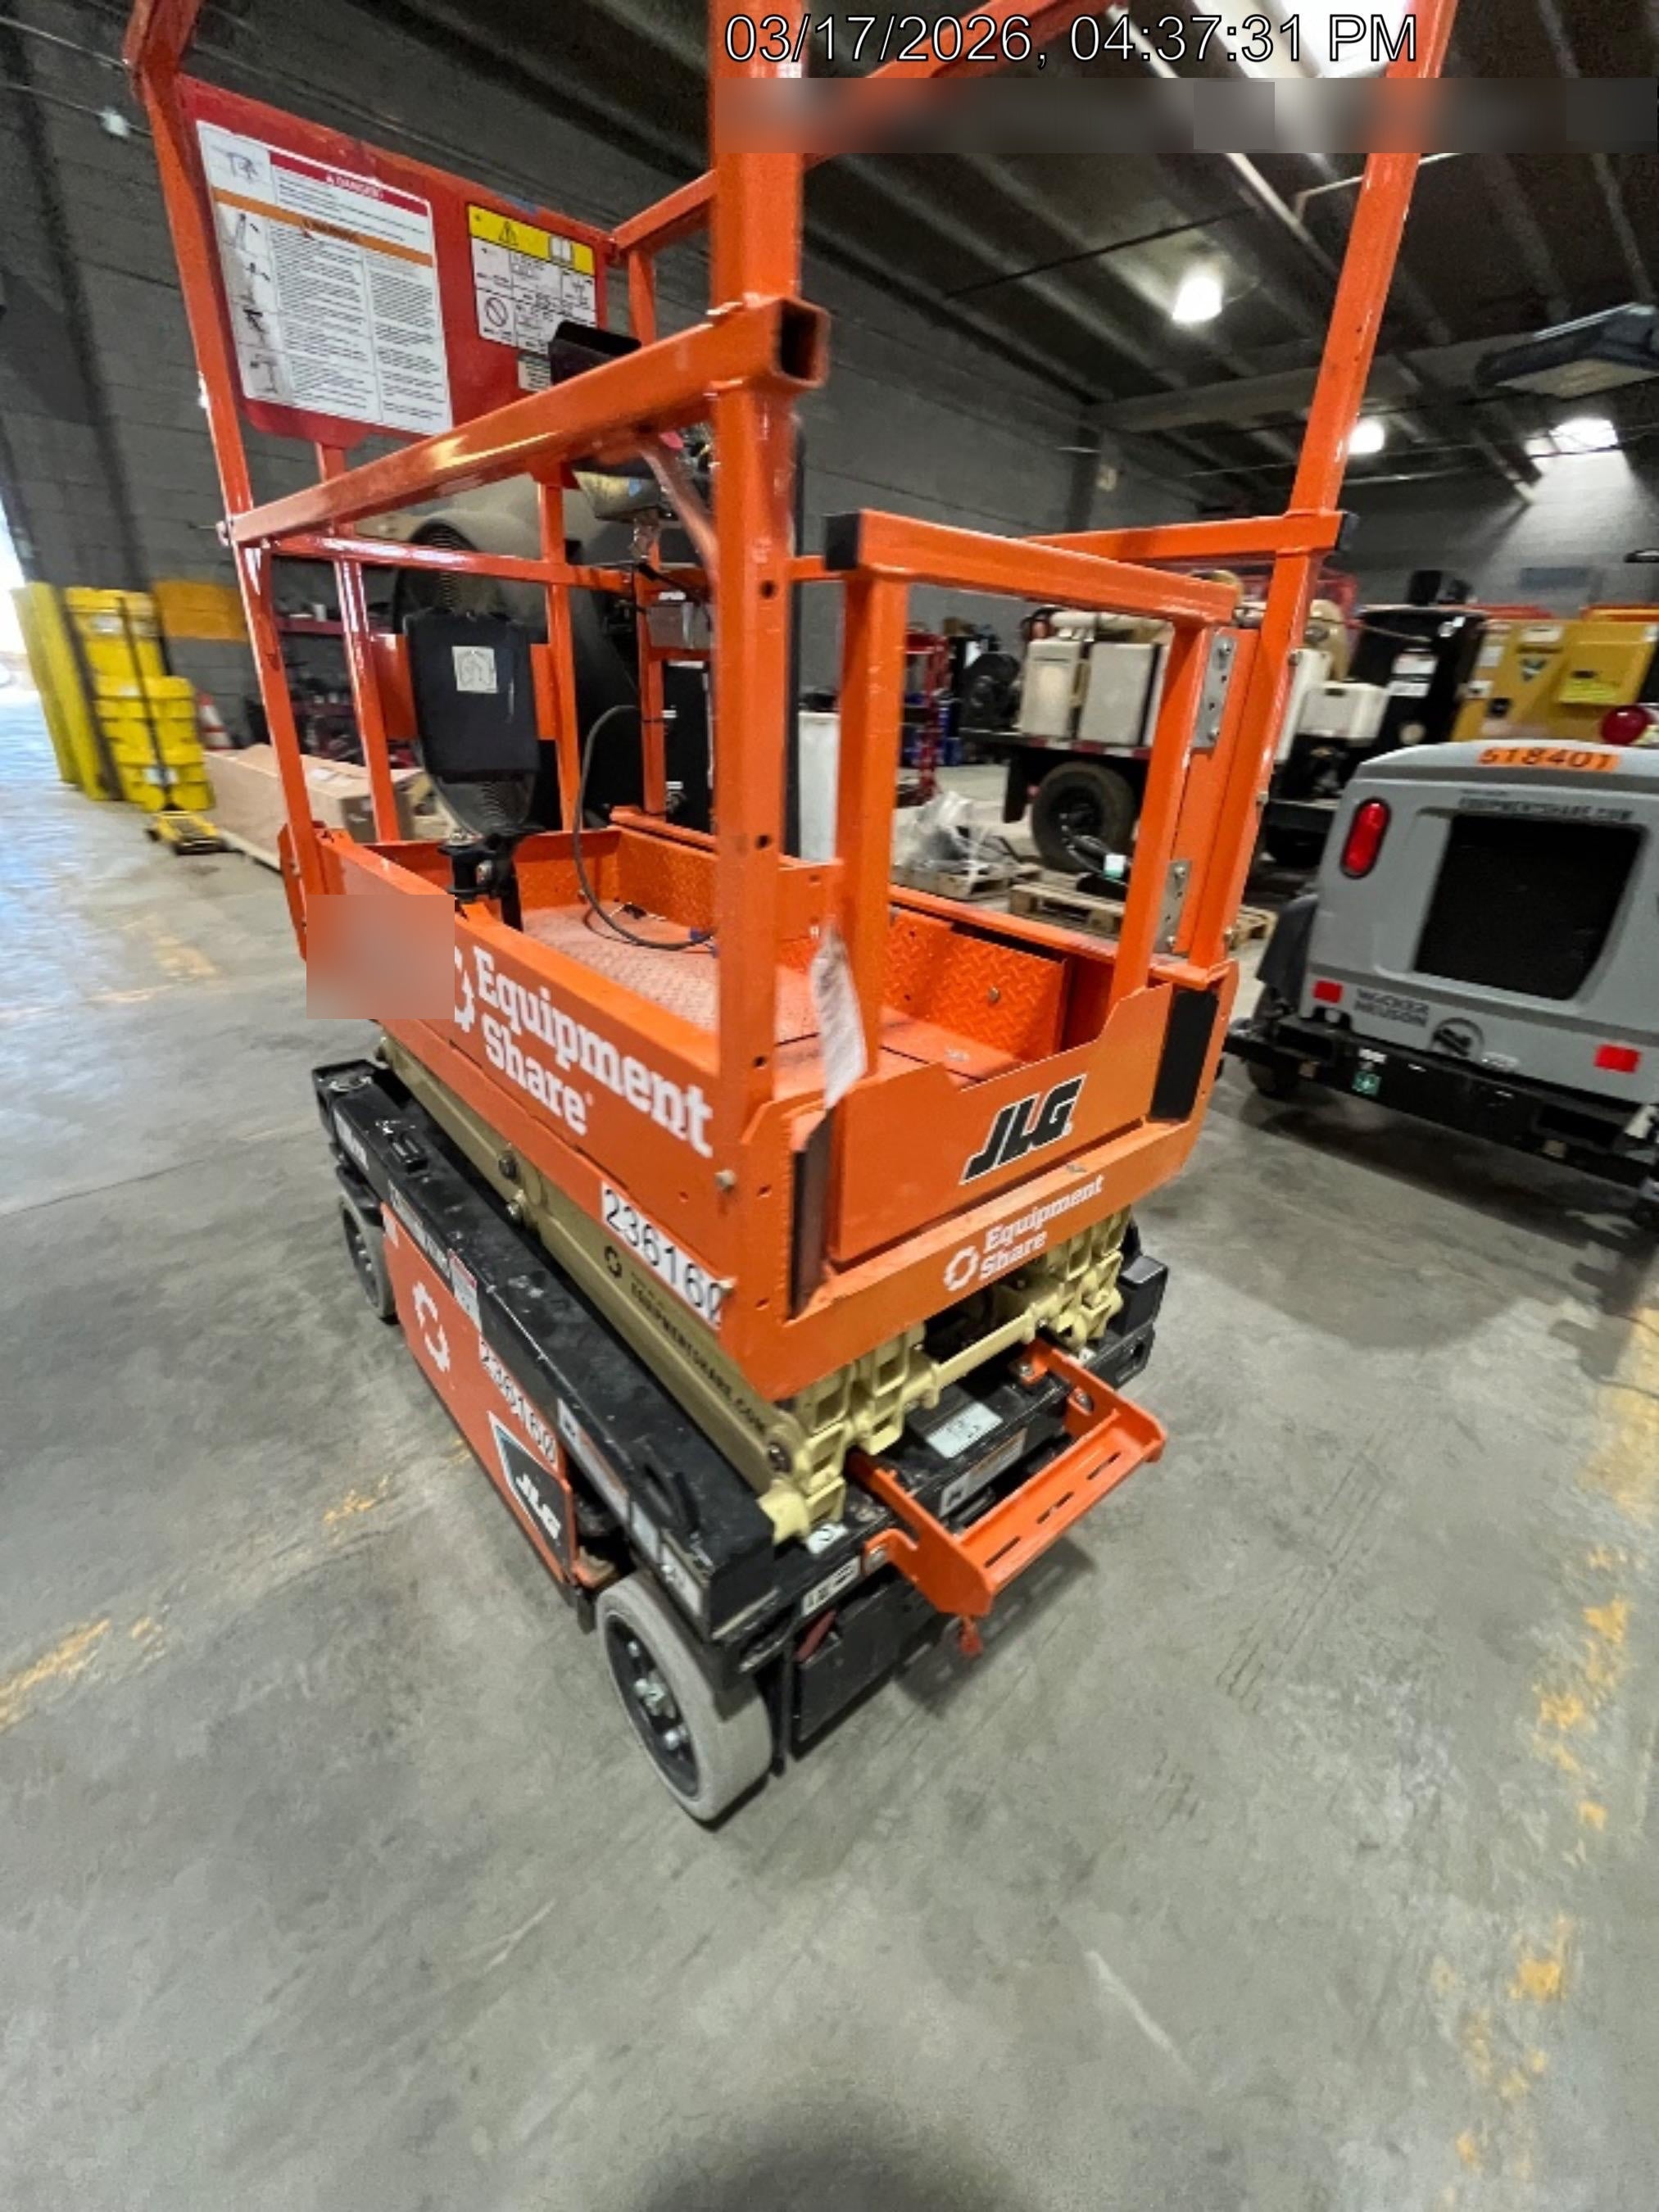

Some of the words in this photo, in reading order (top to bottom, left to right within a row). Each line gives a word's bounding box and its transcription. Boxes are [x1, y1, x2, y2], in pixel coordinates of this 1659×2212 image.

[1479, 747, 1615, 770] 518401
[472, 945, 714, 1158] Equipment
[481, 1012, 587, 1136] Share
[959, 1073, 1087, 1185] JLG
[979, 1231, 1048, 1281] Share
[986, 1174, 1105, 1253] Equipment
